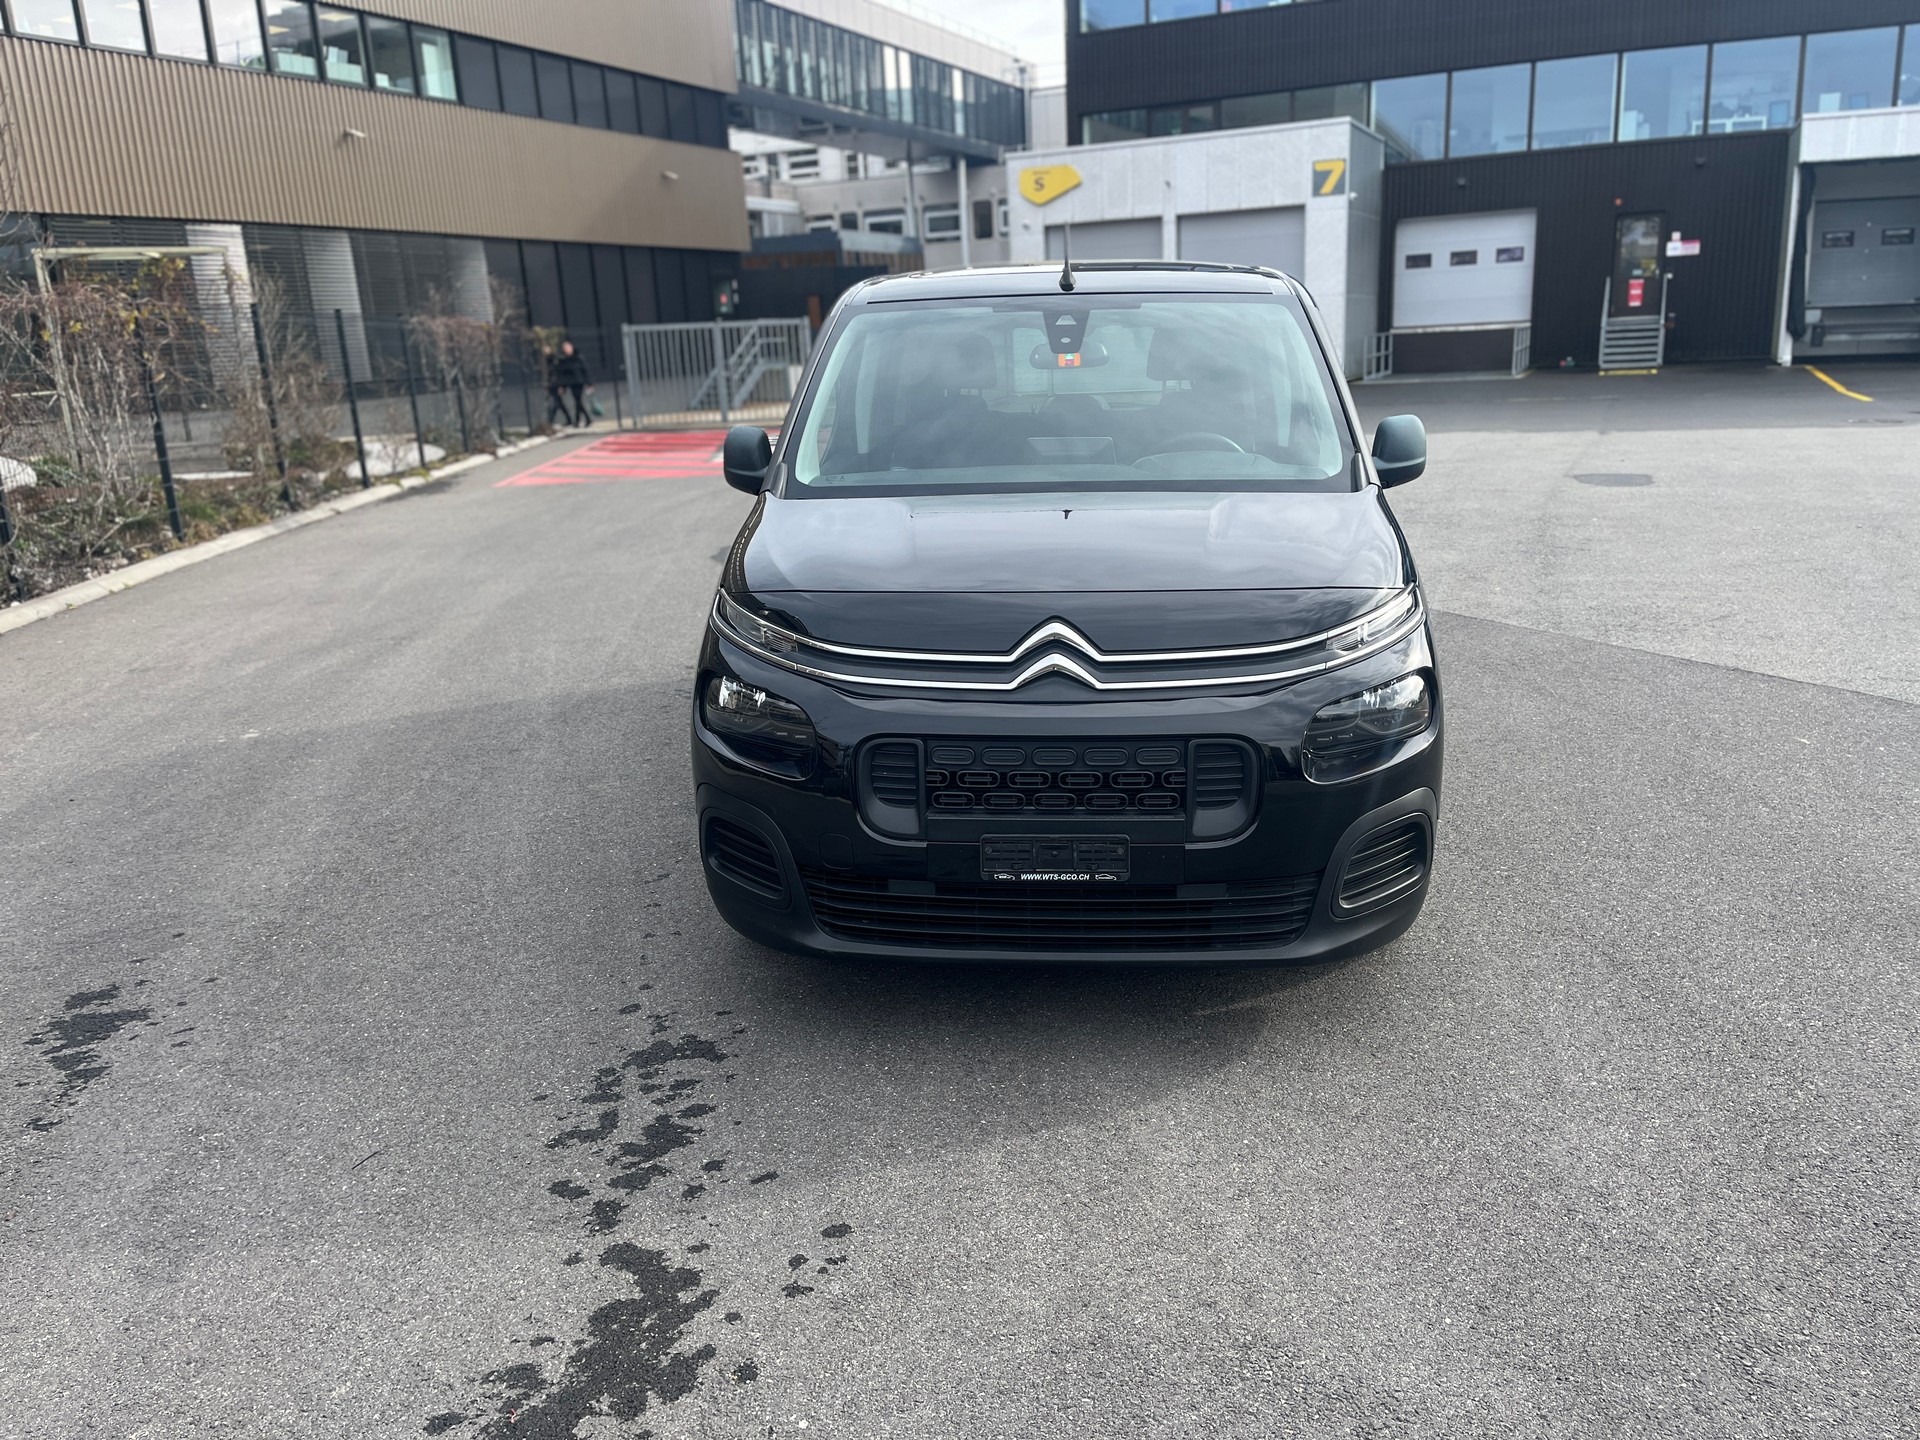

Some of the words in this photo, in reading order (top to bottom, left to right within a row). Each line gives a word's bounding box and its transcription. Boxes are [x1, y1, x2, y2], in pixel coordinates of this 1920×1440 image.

[1034, 176, 1045, 192] S
[1315, 161, 1345, 194] 7
[1020, 873, 1090, 881] WWW.WTS-GCO.CH
